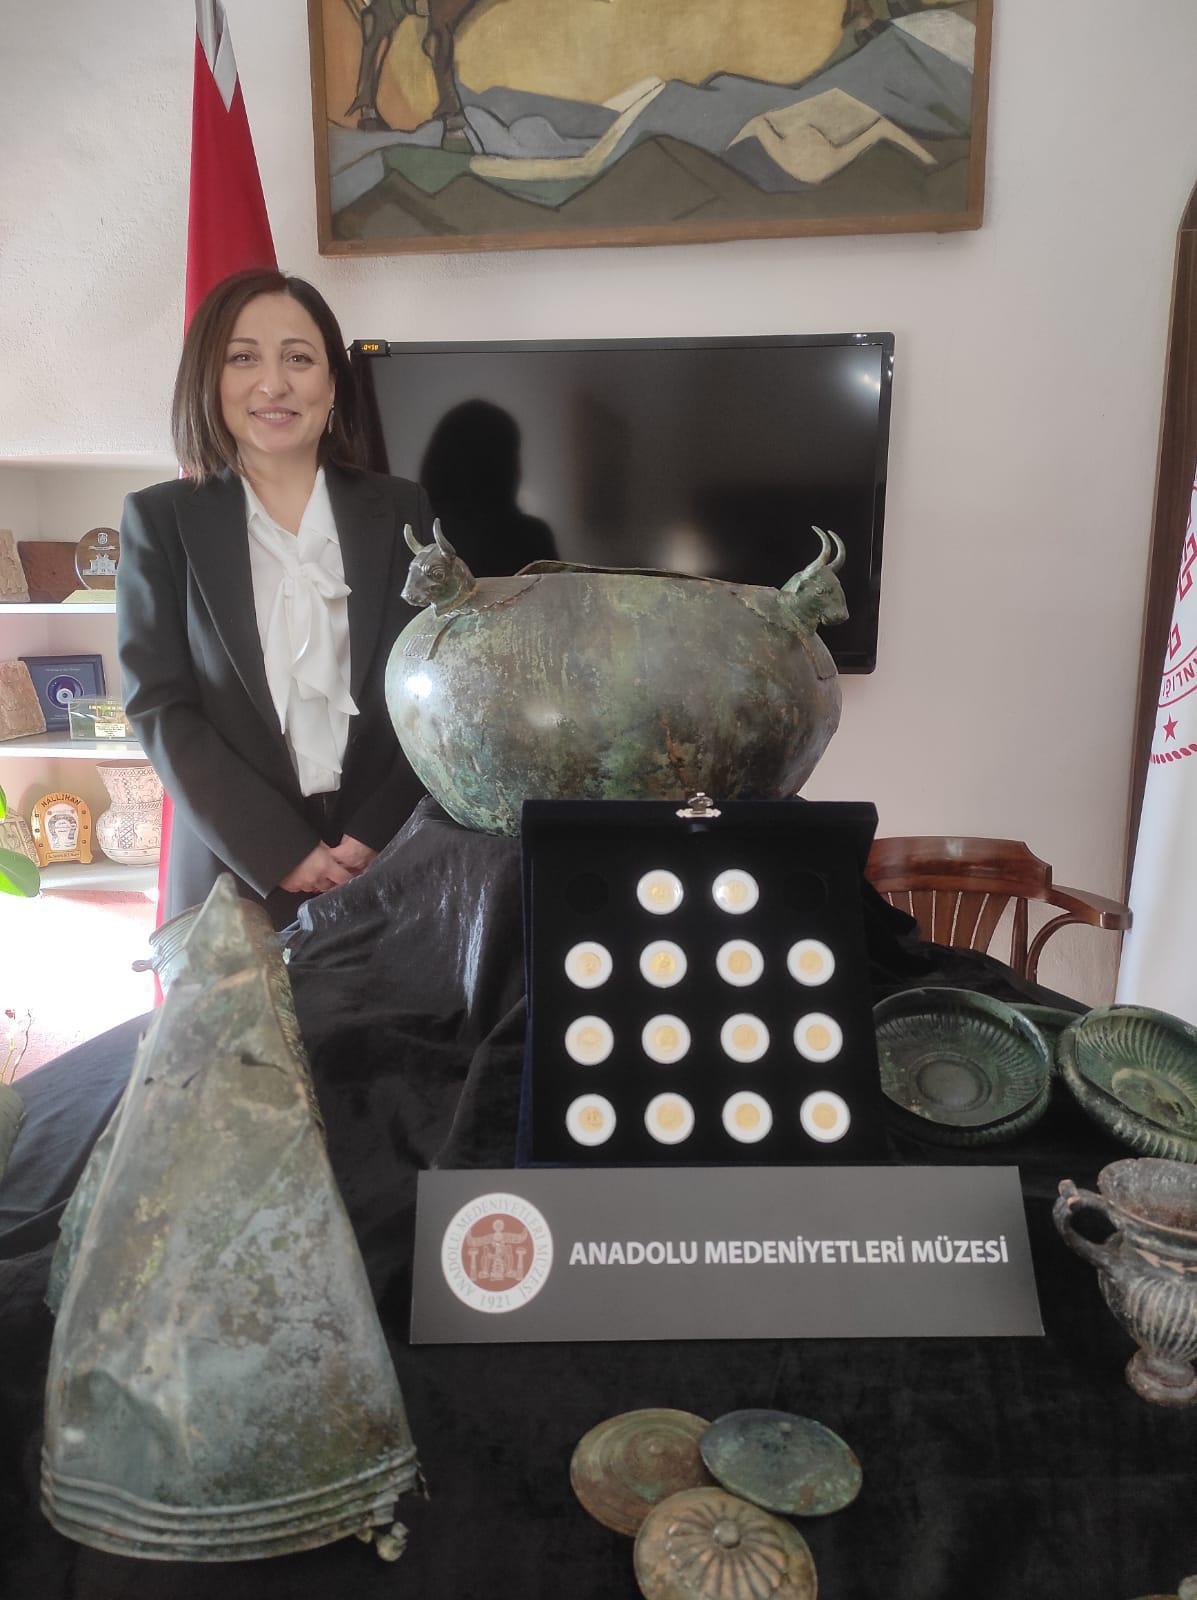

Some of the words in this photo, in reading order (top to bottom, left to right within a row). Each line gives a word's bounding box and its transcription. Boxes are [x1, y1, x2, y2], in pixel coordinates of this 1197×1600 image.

[569, 1241, 697, 1265] ANADOLU
[705, 1236, 905, 1264] MEDENİYETLERİ
[911, 1236, 1009, 1263] MÜZESİ
[481, 1294, 512, 1309] 1921
